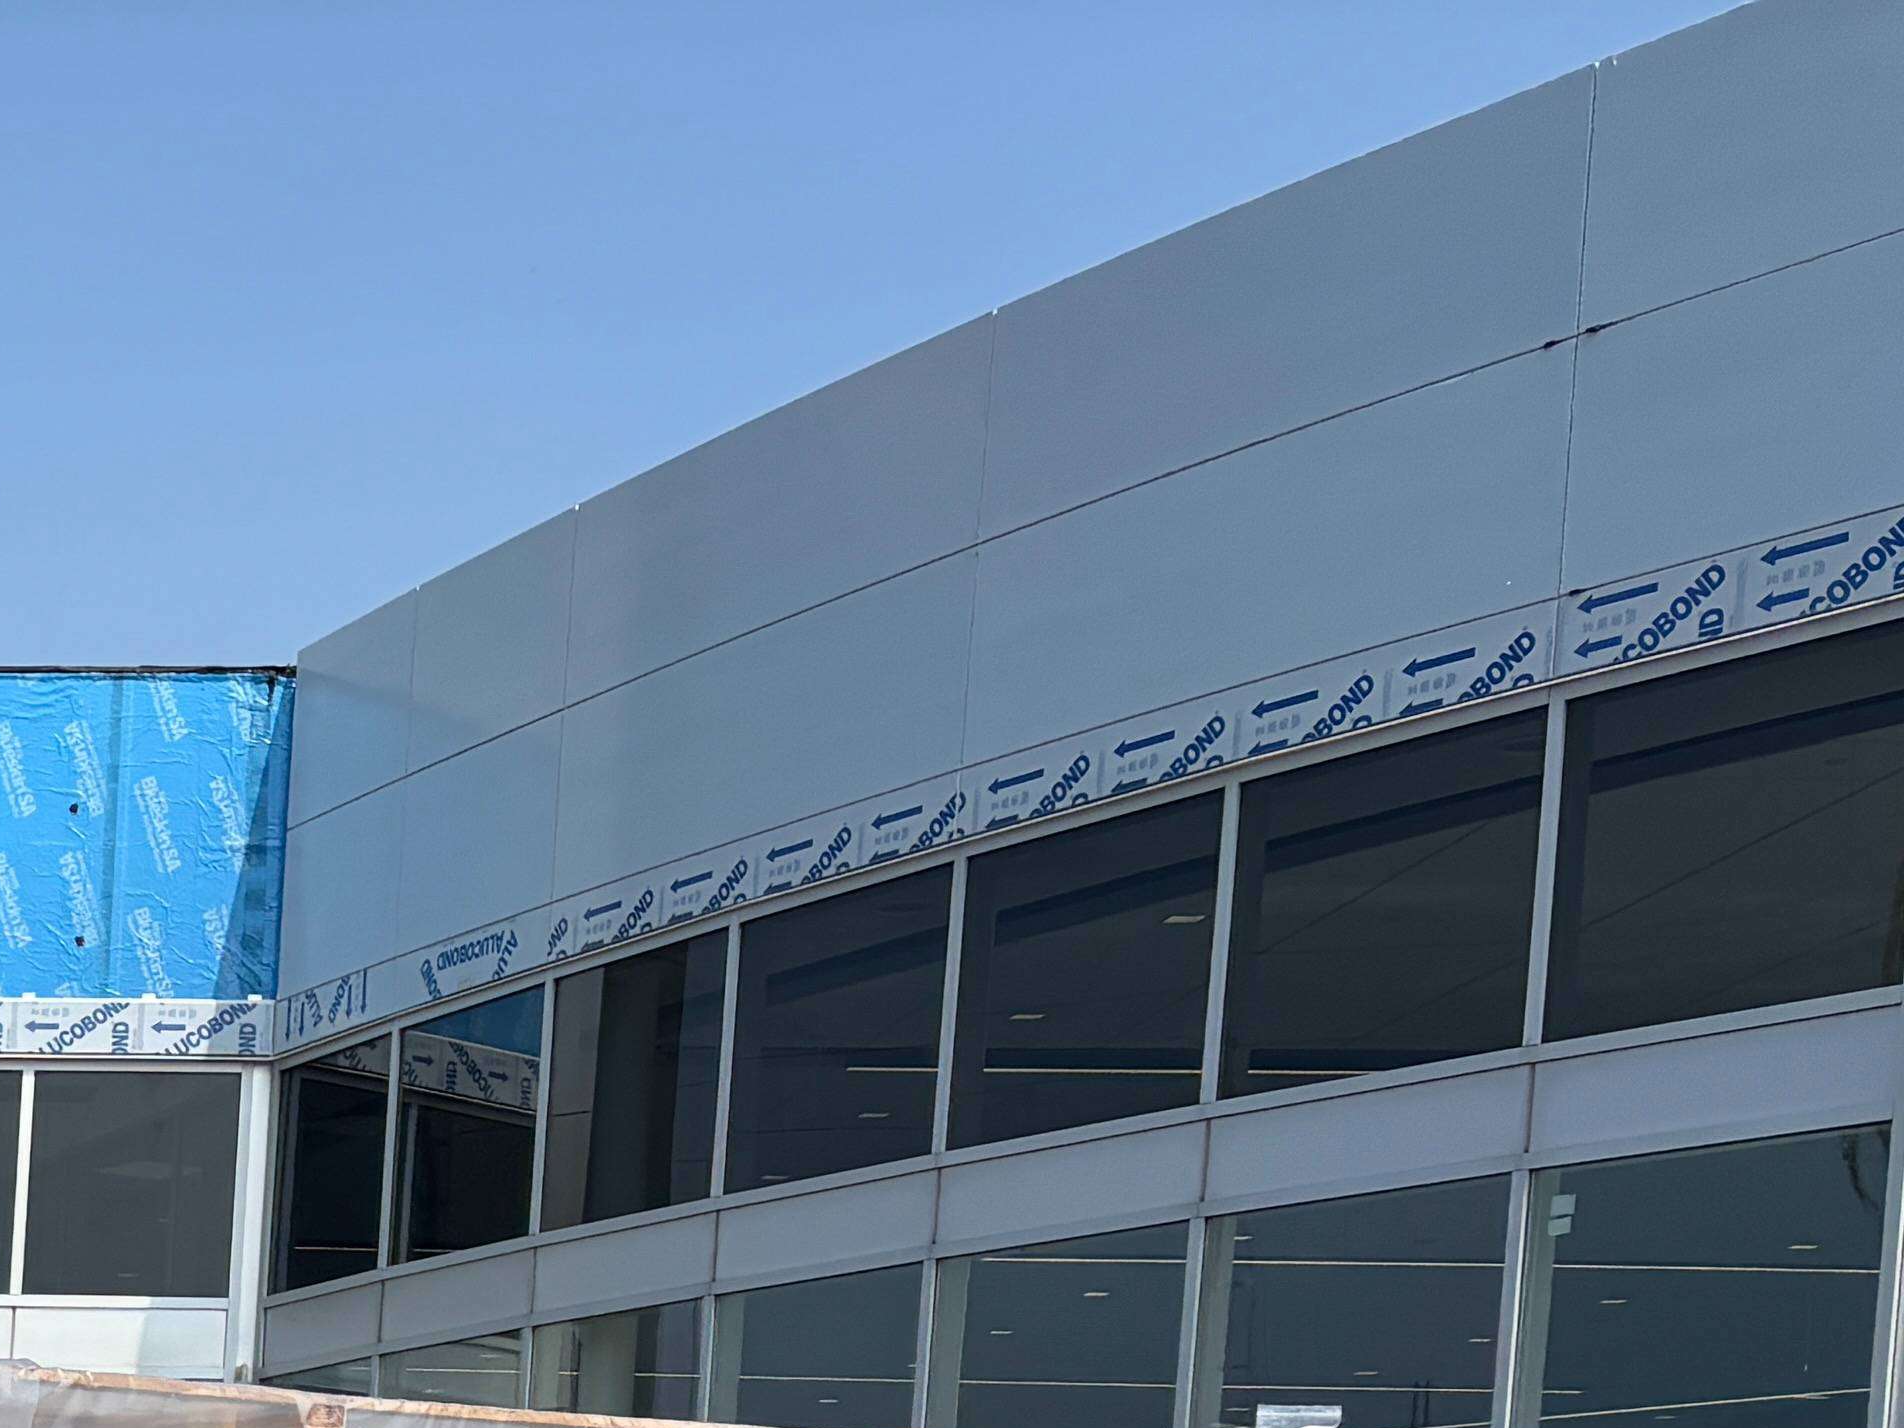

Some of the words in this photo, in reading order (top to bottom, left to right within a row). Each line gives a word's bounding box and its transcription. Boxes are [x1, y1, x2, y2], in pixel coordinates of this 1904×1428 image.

[1613, 564, 1726, 662] COBOND
[39, 1002, 130, 1054] UCOBON
[164, 1002, 257, 1055] UCOBON
